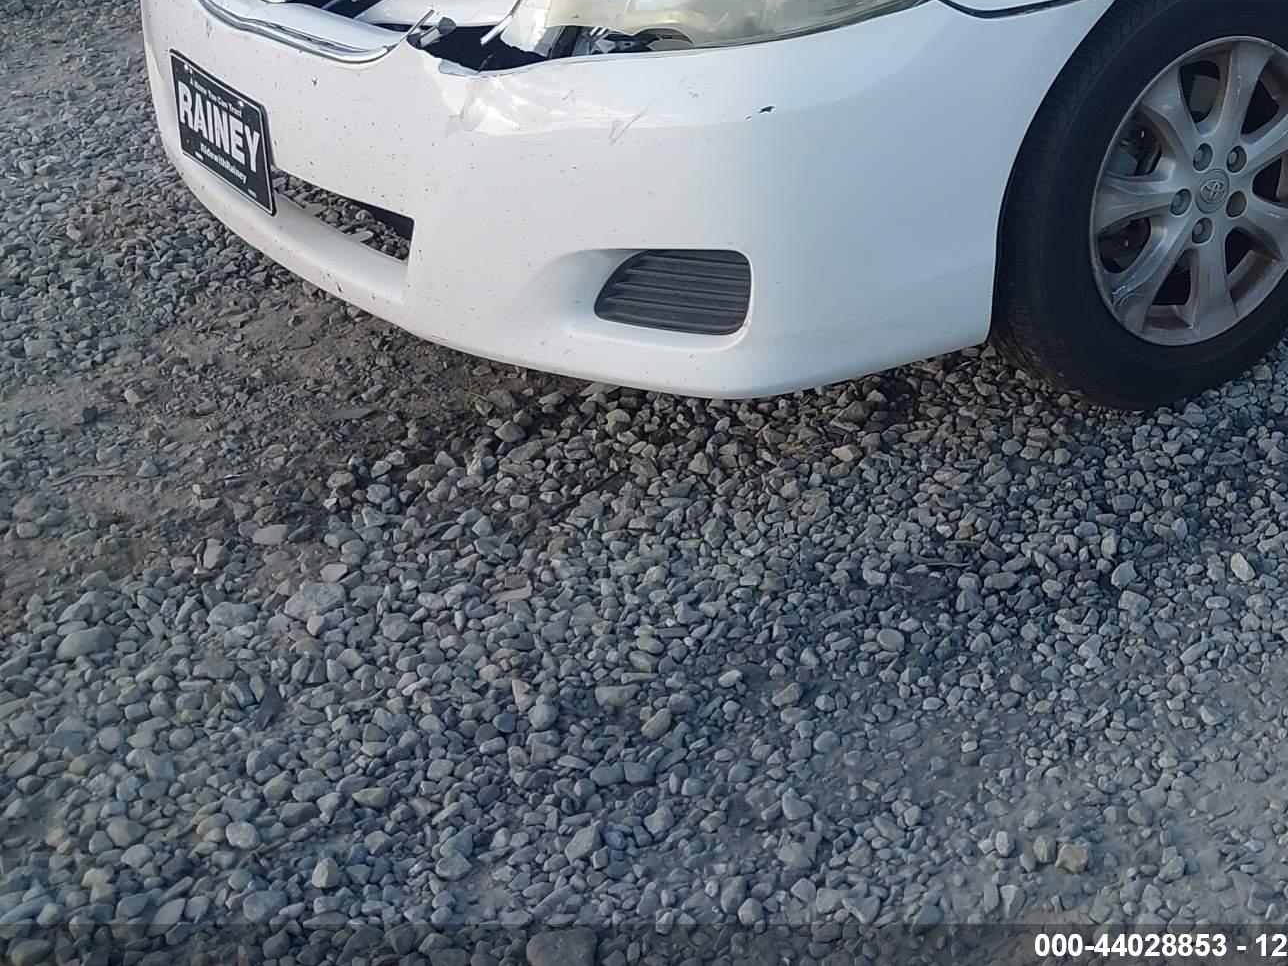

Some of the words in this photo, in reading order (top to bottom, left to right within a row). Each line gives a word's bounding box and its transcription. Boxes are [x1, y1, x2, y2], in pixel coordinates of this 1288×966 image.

[177, 80, 260, 173] RAINEY
[217, 96, 228, 109] Can
[229, 103, 242, 118] Trust
[200, 143, 246, 183] RidewithRainey
